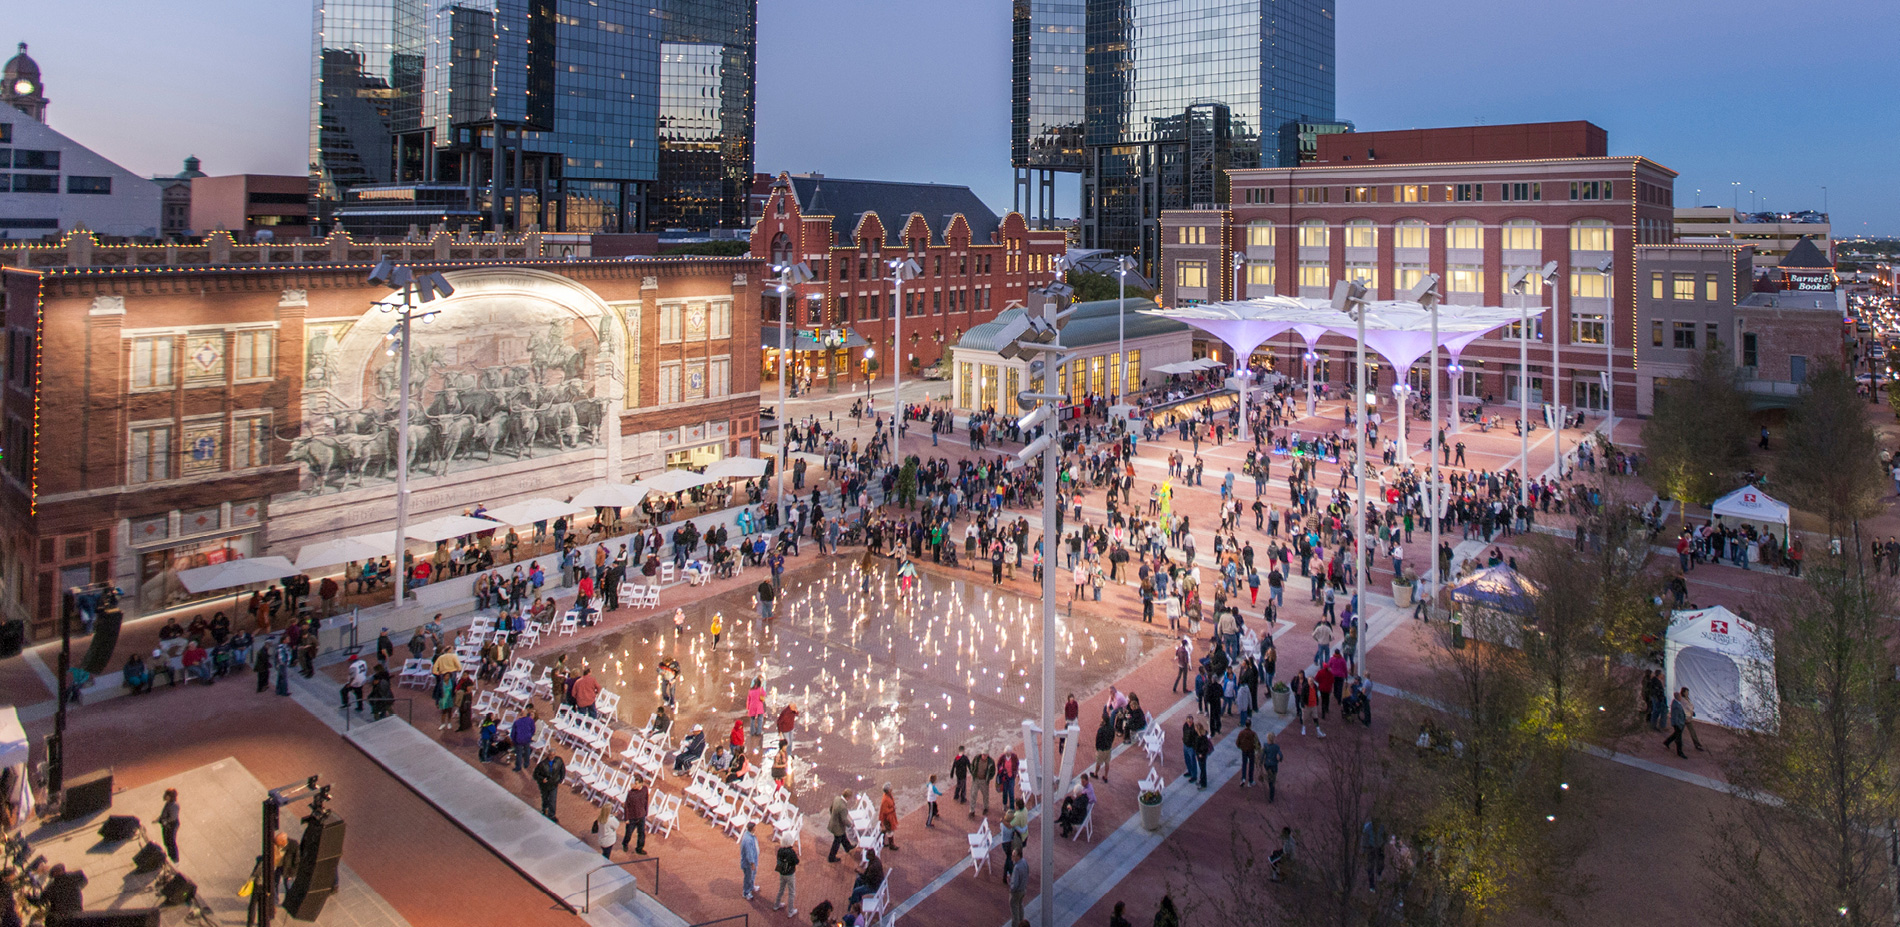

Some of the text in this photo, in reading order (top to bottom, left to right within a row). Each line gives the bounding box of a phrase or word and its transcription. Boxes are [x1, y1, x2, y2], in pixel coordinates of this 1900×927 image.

[457, 277, 535, 289] FORT WORTH
[1790, 274, 1822, 283] Barnes
